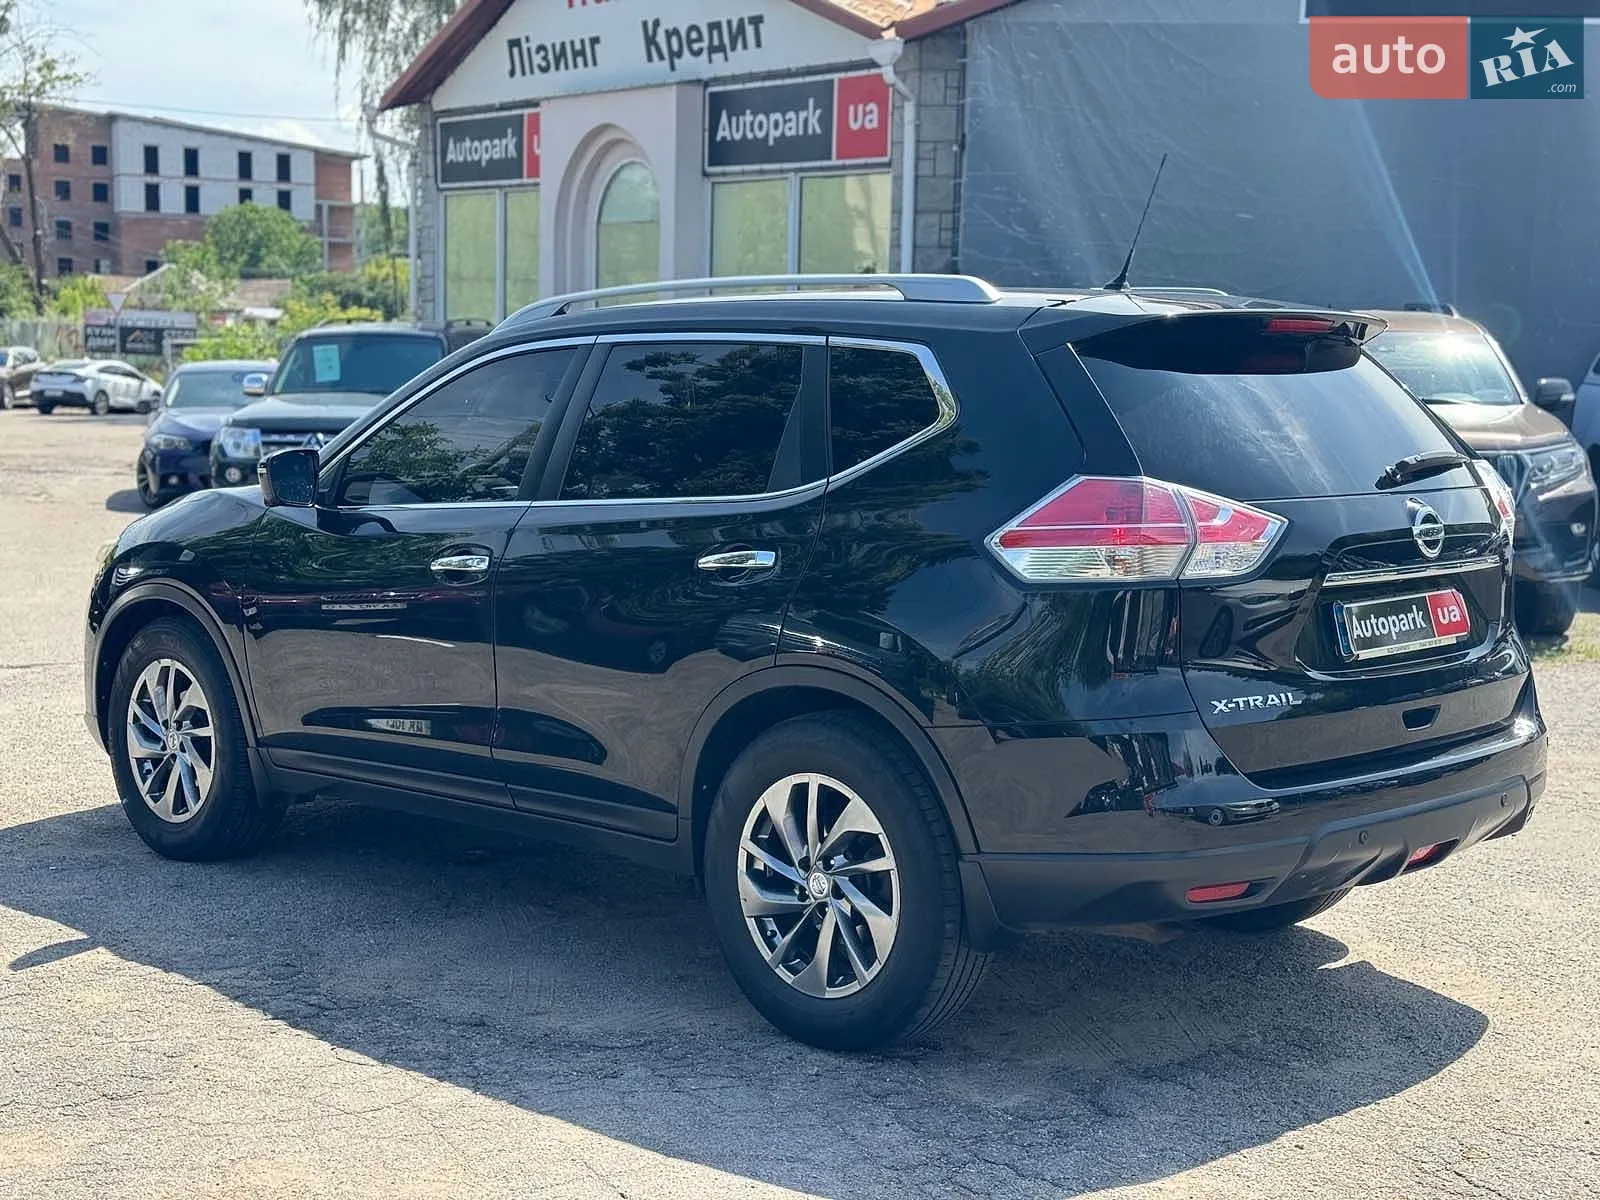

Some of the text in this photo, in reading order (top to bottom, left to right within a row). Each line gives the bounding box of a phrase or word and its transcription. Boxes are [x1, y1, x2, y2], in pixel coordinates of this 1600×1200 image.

[507, 14, 764, 78] Лізинг Кредит
[716, 97, 879, 146] Autopark ua
[446, 127, 518, 167] Autopark
[1353, 605, 1461, 640] Autopark ua
[1210, 692, 1303, 714] X-TRAIL
